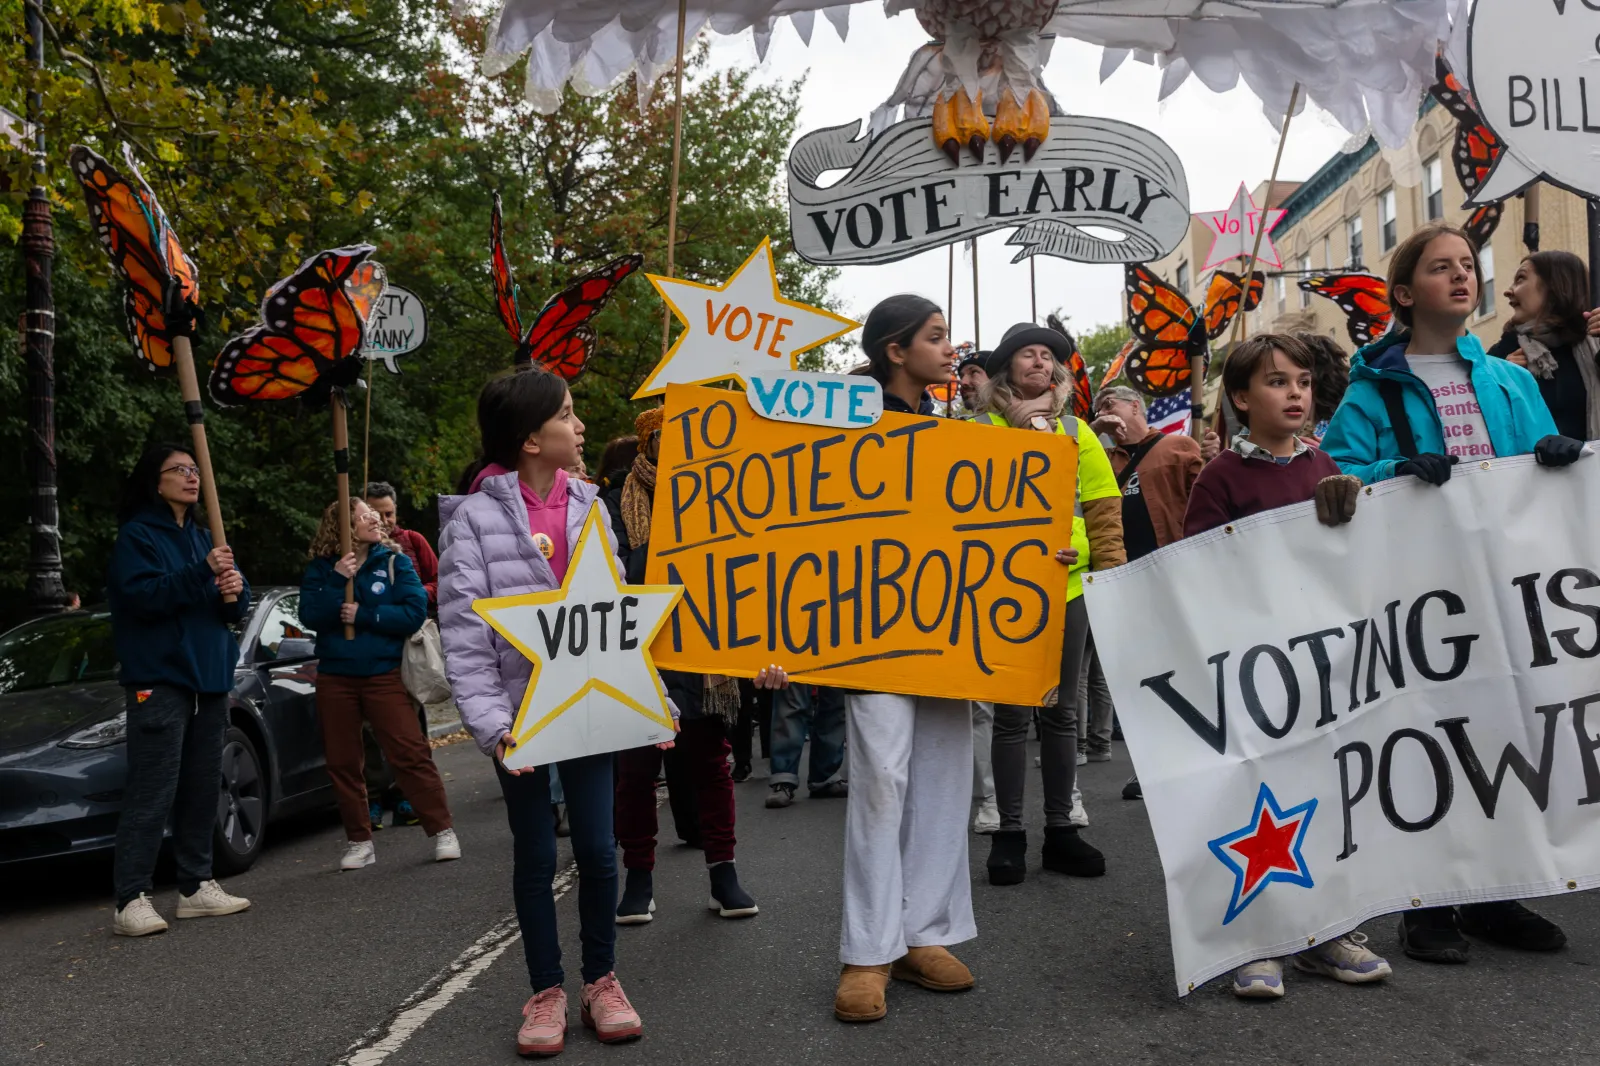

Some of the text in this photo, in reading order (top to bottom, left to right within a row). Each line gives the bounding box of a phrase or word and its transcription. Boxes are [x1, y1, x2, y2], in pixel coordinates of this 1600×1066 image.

[806, 166, 1171, 256] VOTE EARLY
[706, 298, 794, 359] VOTE
[668, 400, 738, 460] TO
[750, 376, 876, 424] VOTE
[670, 420, 1053, 544] PROTECT OUR
[536, 596, 639, 661] VOTE
[666, 538, 1050, 675] NEIGHBORS
[1140, 567, 1600, 756] VOTING IS
